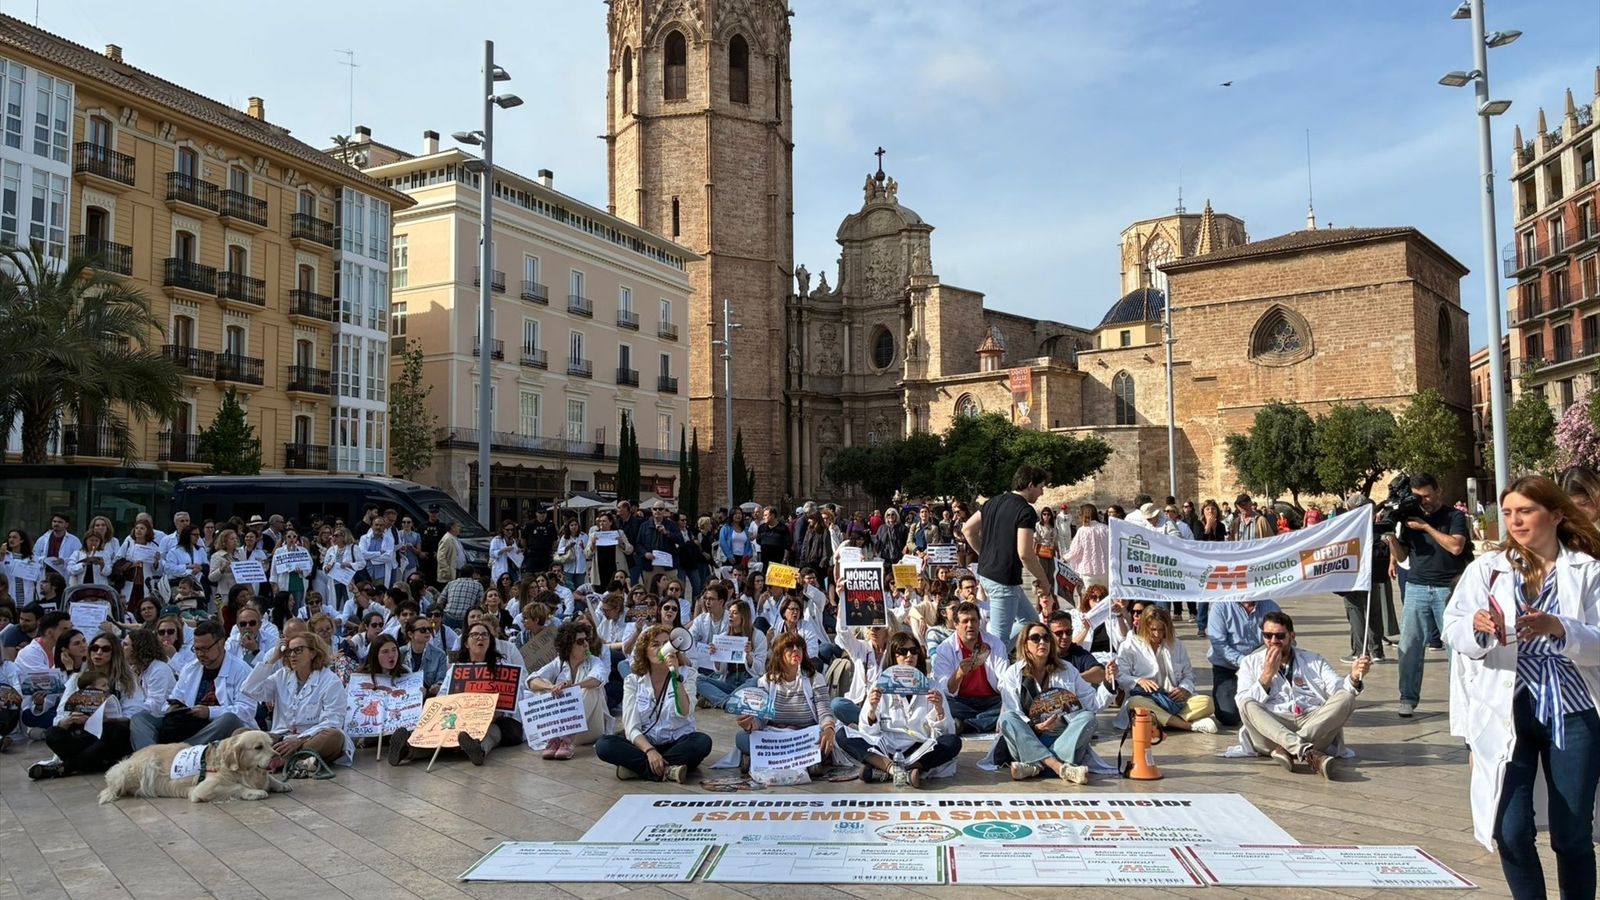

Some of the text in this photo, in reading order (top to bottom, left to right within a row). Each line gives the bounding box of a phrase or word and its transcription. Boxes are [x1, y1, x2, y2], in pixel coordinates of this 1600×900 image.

[1127, 547, 1177, 567] Estatuto
[1313, 542, 1349, 561] OFERTA
[1128, 564, 1142, 574] del
[1249, 558, 1297, 573] Sindicato
[1313, 557, 1350, 577] MÉDICO
[846, 569, 879, 581] MÓNICA
[1254, 574, 1294, 588] Médico
[846, 580, 880, 591] GARCÍA
[1128, 576, 1186, 591] y Facultativo
[453, 667, 471, 680] SE
[469, 682, 483, 691] TU
[537, 714, 584, 729] Nuestras guardias
[768, 757, 793, 766] Nuestras
[653, 800, 824, 808] Condiciones
[1009, 799, 1101, 807] cuidar
[1107, 799, 1192, 807] mejor
[691, 811, 890, 822] ¡SALVEMOS
[900, 811, 942, 821] LA
